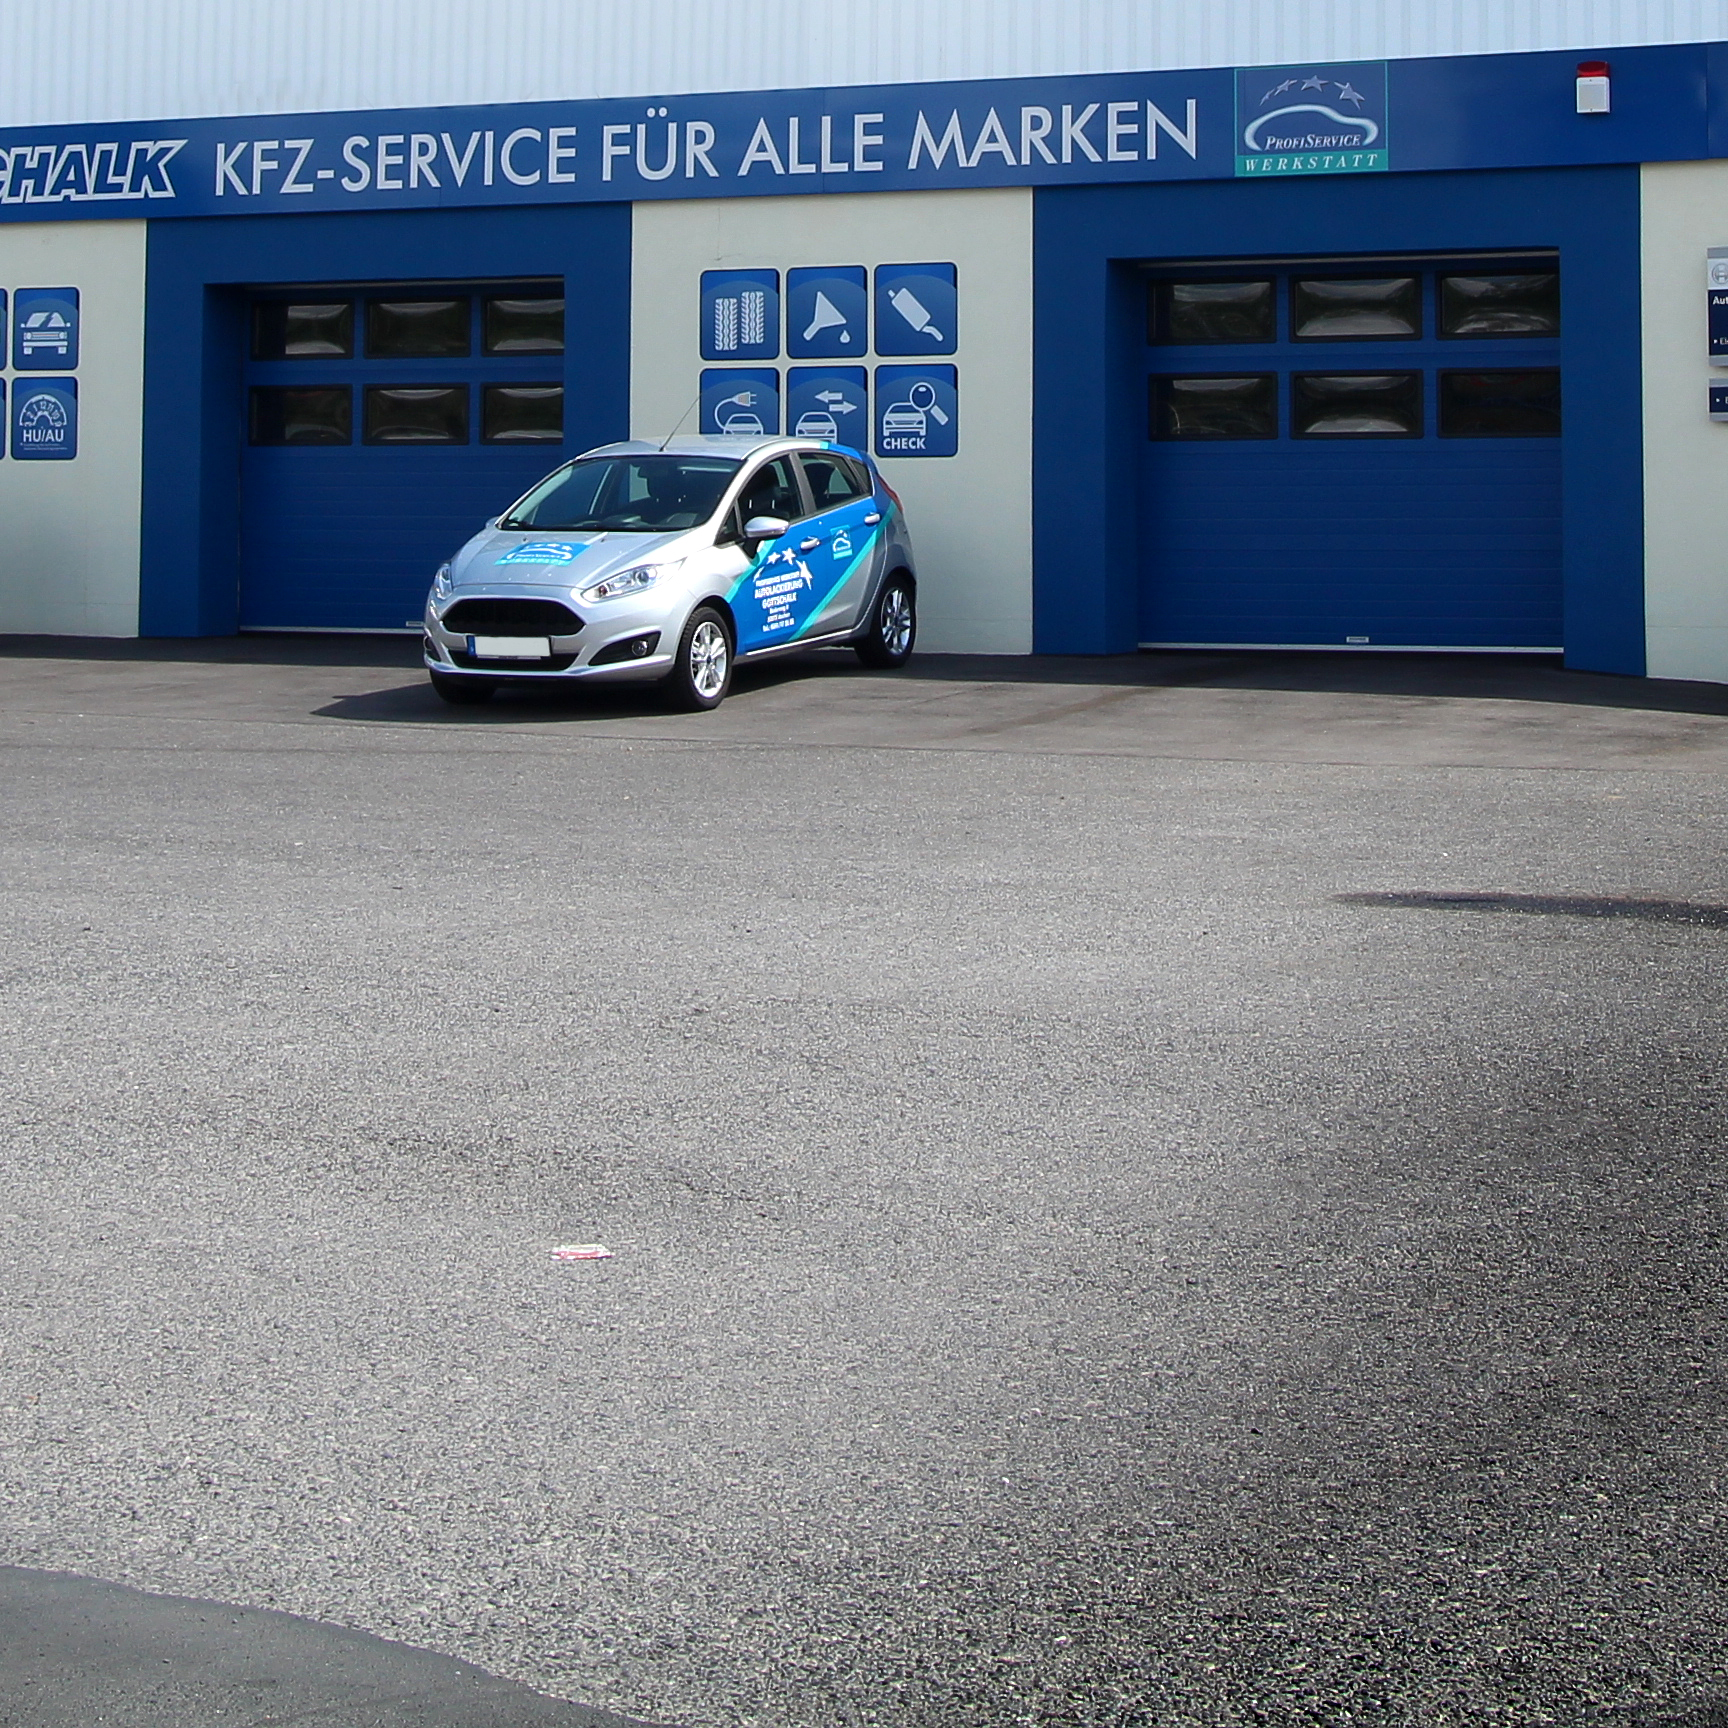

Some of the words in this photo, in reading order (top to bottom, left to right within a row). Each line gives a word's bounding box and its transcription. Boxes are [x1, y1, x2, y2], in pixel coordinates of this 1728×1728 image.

[215, 126, 576, 197] KFZ-SERVICE
[602, 106, 719, 181] FÜR
[737, 112, 885, 176] ALLE
[907, 98, 1197, 170] MARKEN
[1245, 153, 1378, 172] WERKSTATT
[883, 437, 926, 450] CHECK
